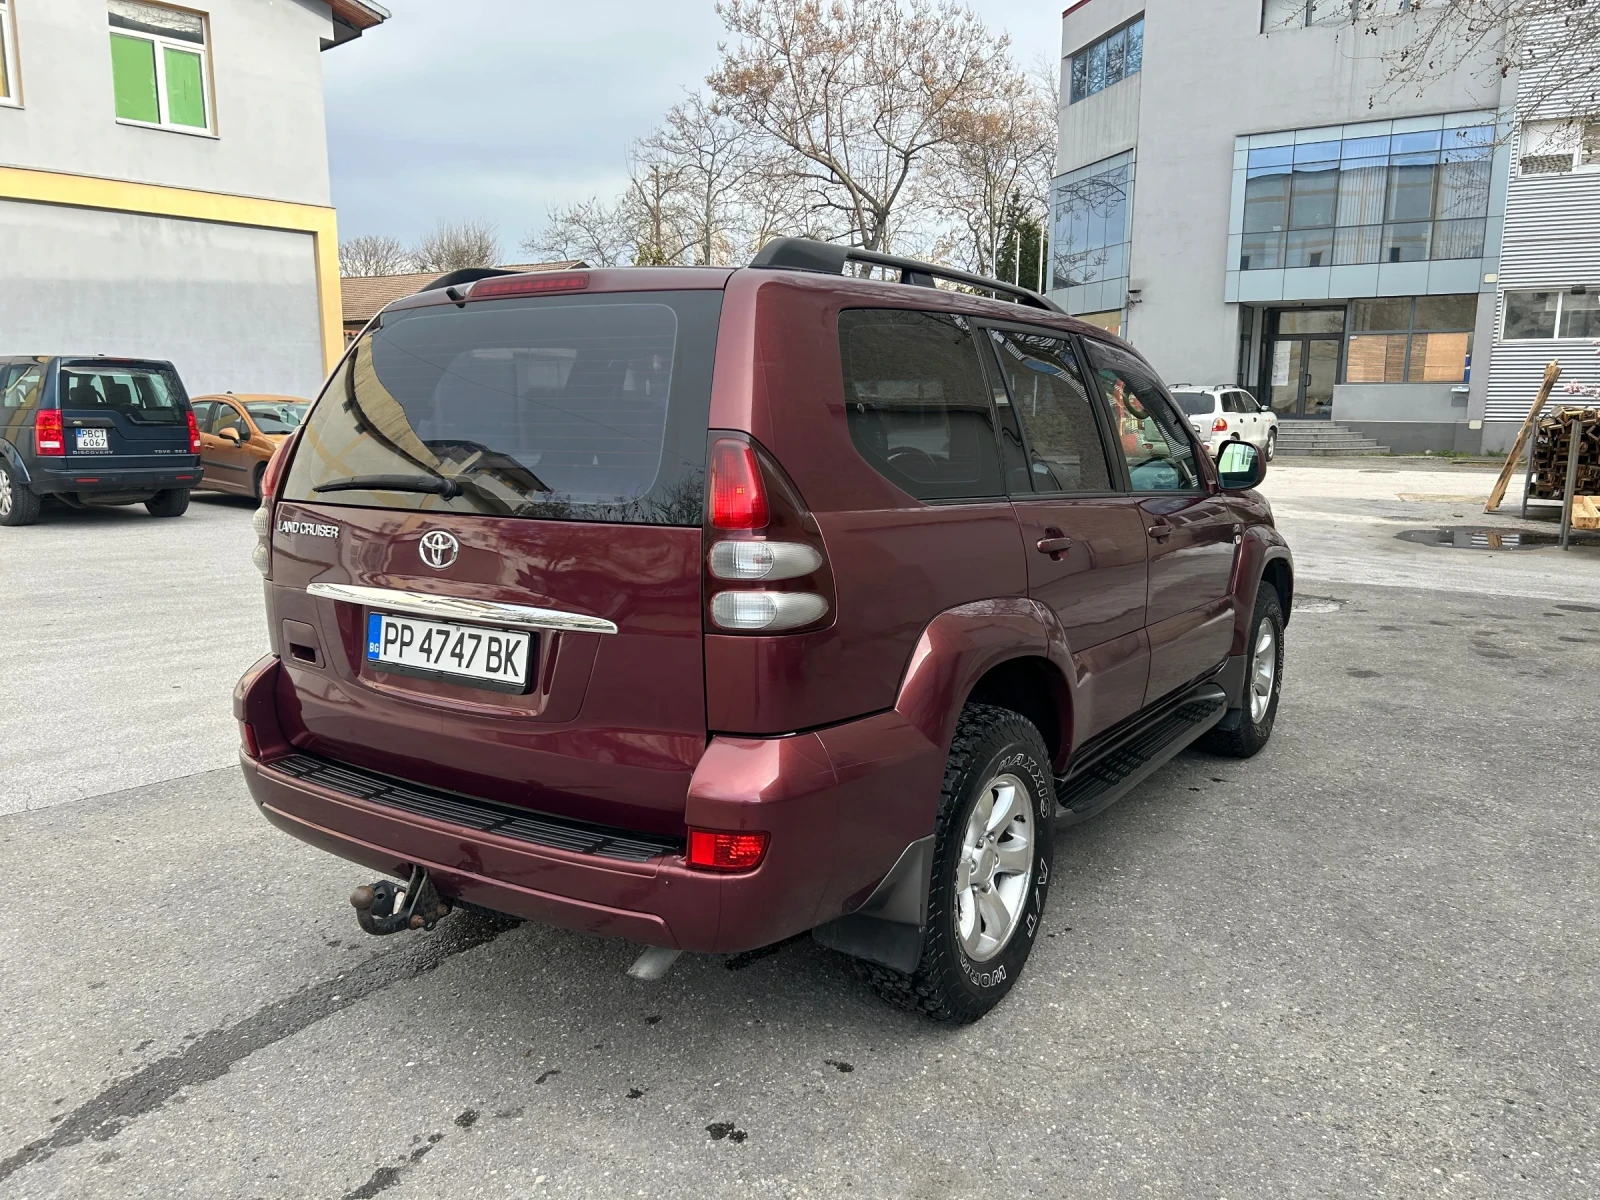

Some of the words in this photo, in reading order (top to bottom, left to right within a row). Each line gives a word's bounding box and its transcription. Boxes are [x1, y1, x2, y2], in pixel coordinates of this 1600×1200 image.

[83, 439, 106, 447] 6067
[278, 520, 300, 534] LAND
[300, 522, 339, 539] CRUISER
[369, 642, 379, 653] BG
[384, 622, 414, 658] PP
[418, 628, 482, 669] 4747
[485, 636, 522, 677] BK
[995, 753, 1051, 819] MAXXIS
